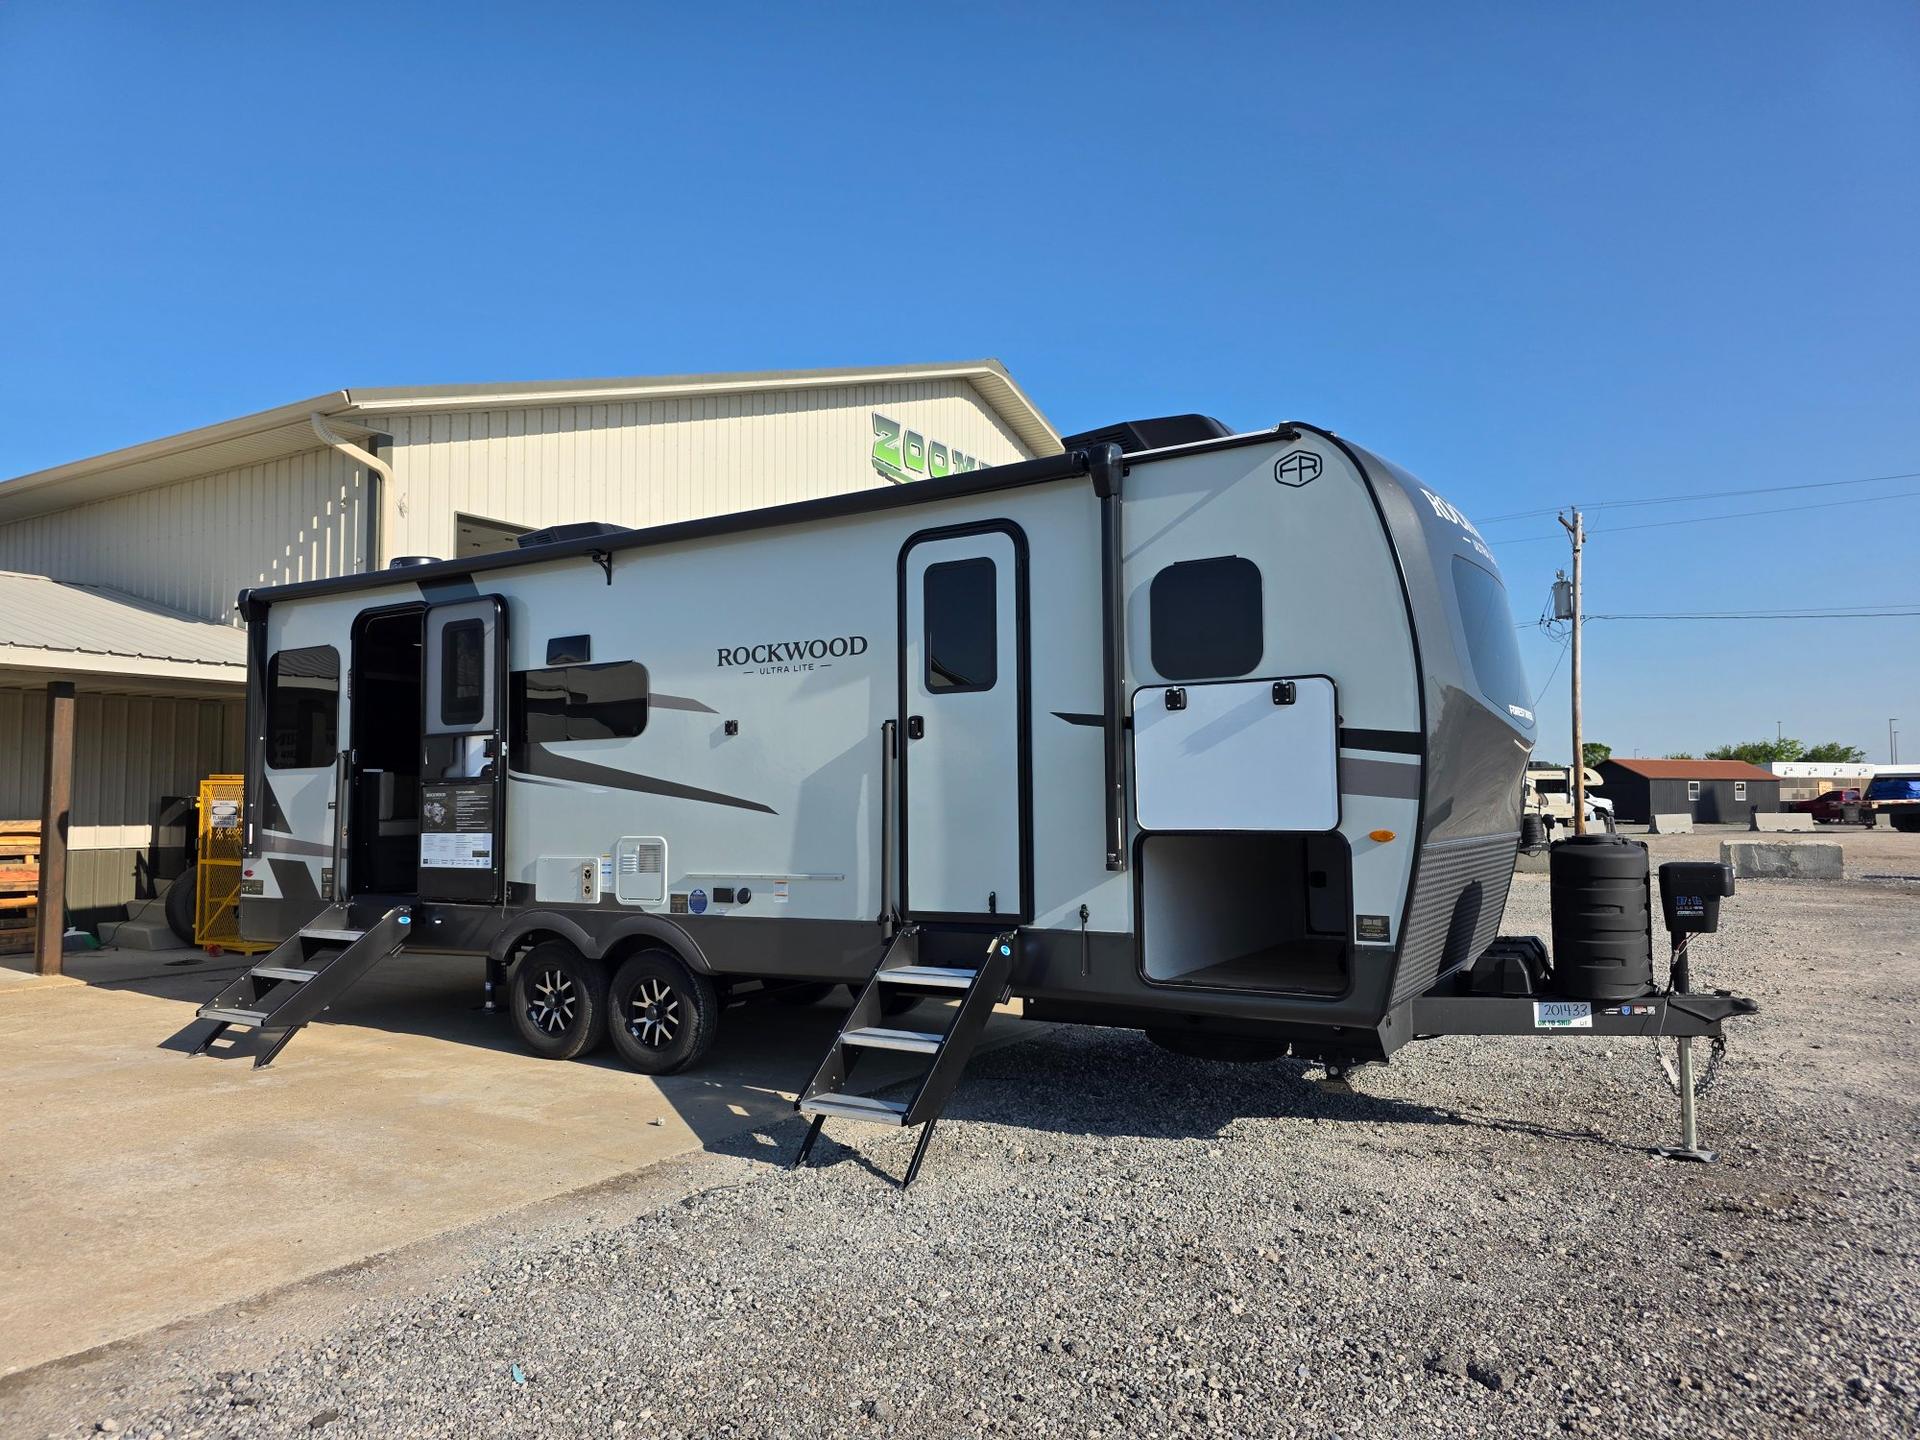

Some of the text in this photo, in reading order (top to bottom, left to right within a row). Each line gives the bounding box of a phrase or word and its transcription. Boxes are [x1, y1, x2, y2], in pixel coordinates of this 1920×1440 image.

[872, 411, 993, 478] ZOOM
[1279, 454, 1318, 482] FR
[717, 636, 868, 667] ROCKWOOD
[759, 664, 814, 675] ULTRA LITE
[1543, 1004, 1588, 1017] 201433
